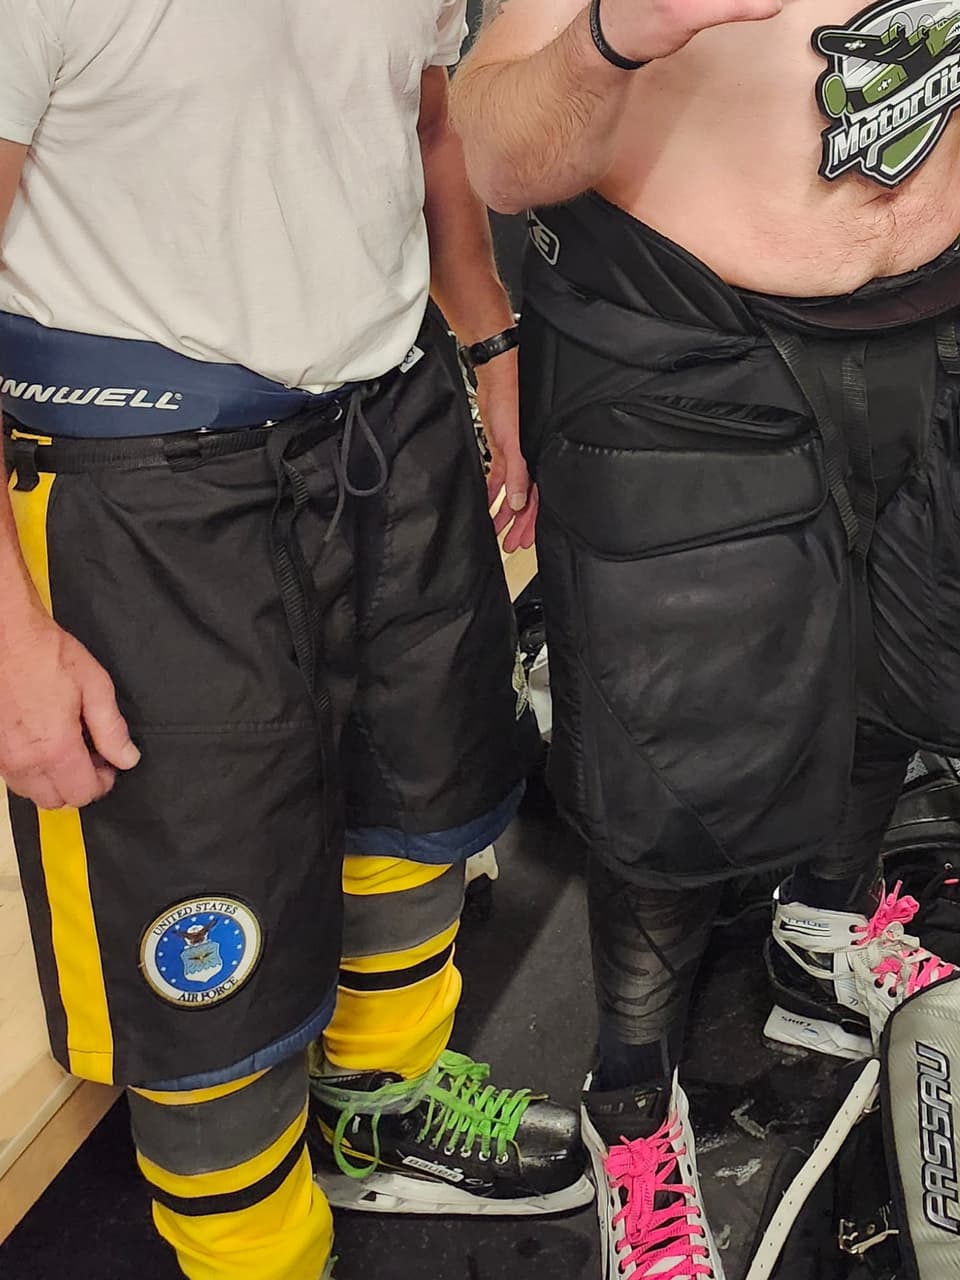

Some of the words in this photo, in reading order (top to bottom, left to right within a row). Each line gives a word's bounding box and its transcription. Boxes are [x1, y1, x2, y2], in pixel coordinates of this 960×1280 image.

[0, 375, 180, 410] NNWELL
[153, 906, 193, 937] UNITED
[195, 901, 239, 916] STATES
[177, 991, 199, 1003] AIR
[200, 976, 239, 1002] FORCE
